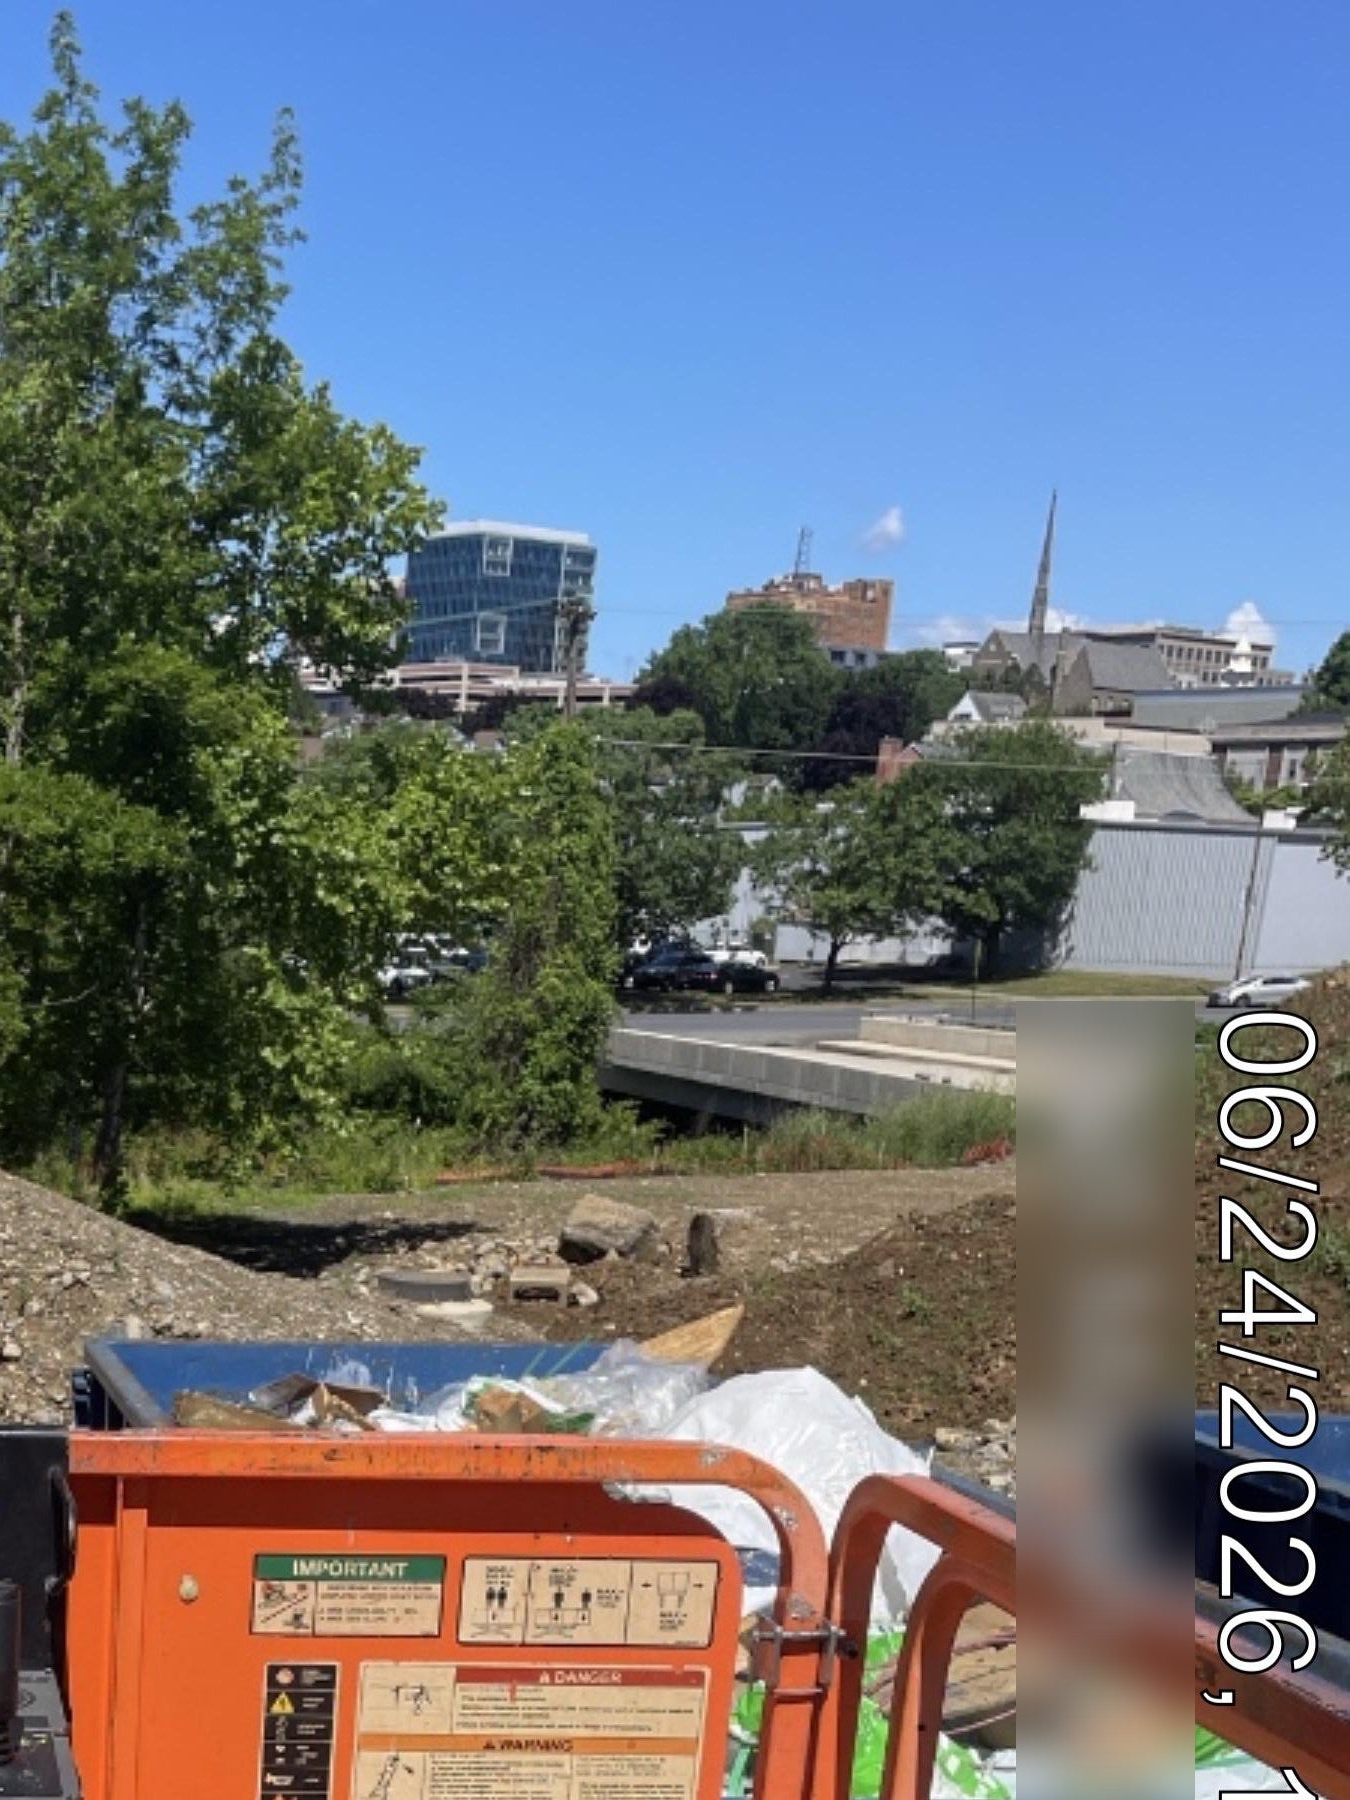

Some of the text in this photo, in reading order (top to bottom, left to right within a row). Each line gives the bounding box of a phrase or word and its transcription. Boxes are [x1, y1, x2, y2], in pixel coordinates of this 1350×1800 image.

[292, 1558, 410, 1580] IMPORTANT
[553, 1670, 622, 1684] DANGER
[499, 1739, 574, 1753] WARNING
